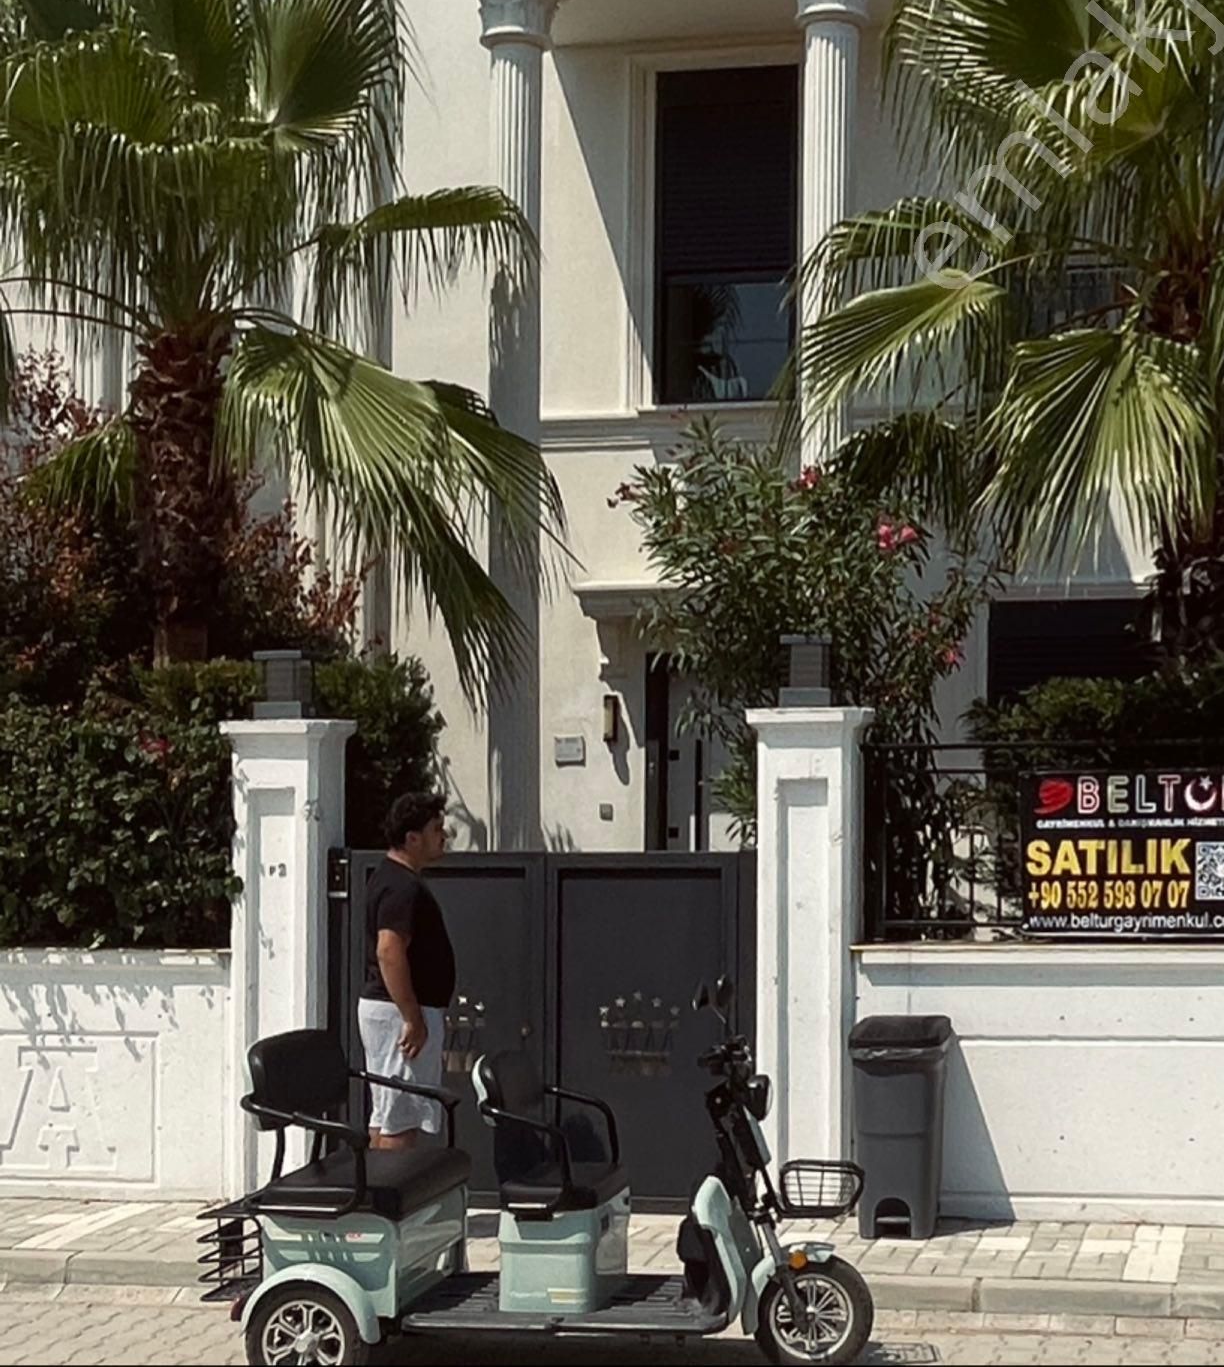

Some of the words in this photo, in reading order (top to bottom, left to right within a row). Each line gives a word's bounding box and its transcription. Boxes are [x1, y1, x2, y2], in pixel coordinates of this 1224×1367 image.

[1026, 838, 1192, 876] SATILIK
[1028, 881, 1062, 909] +90
[1066, 881, 1099, 909] 552
[1103, 880, 1136, 909] 593
[1141, 880, 1163, 908] 07
[1167, 880, 1190, 908] 07
